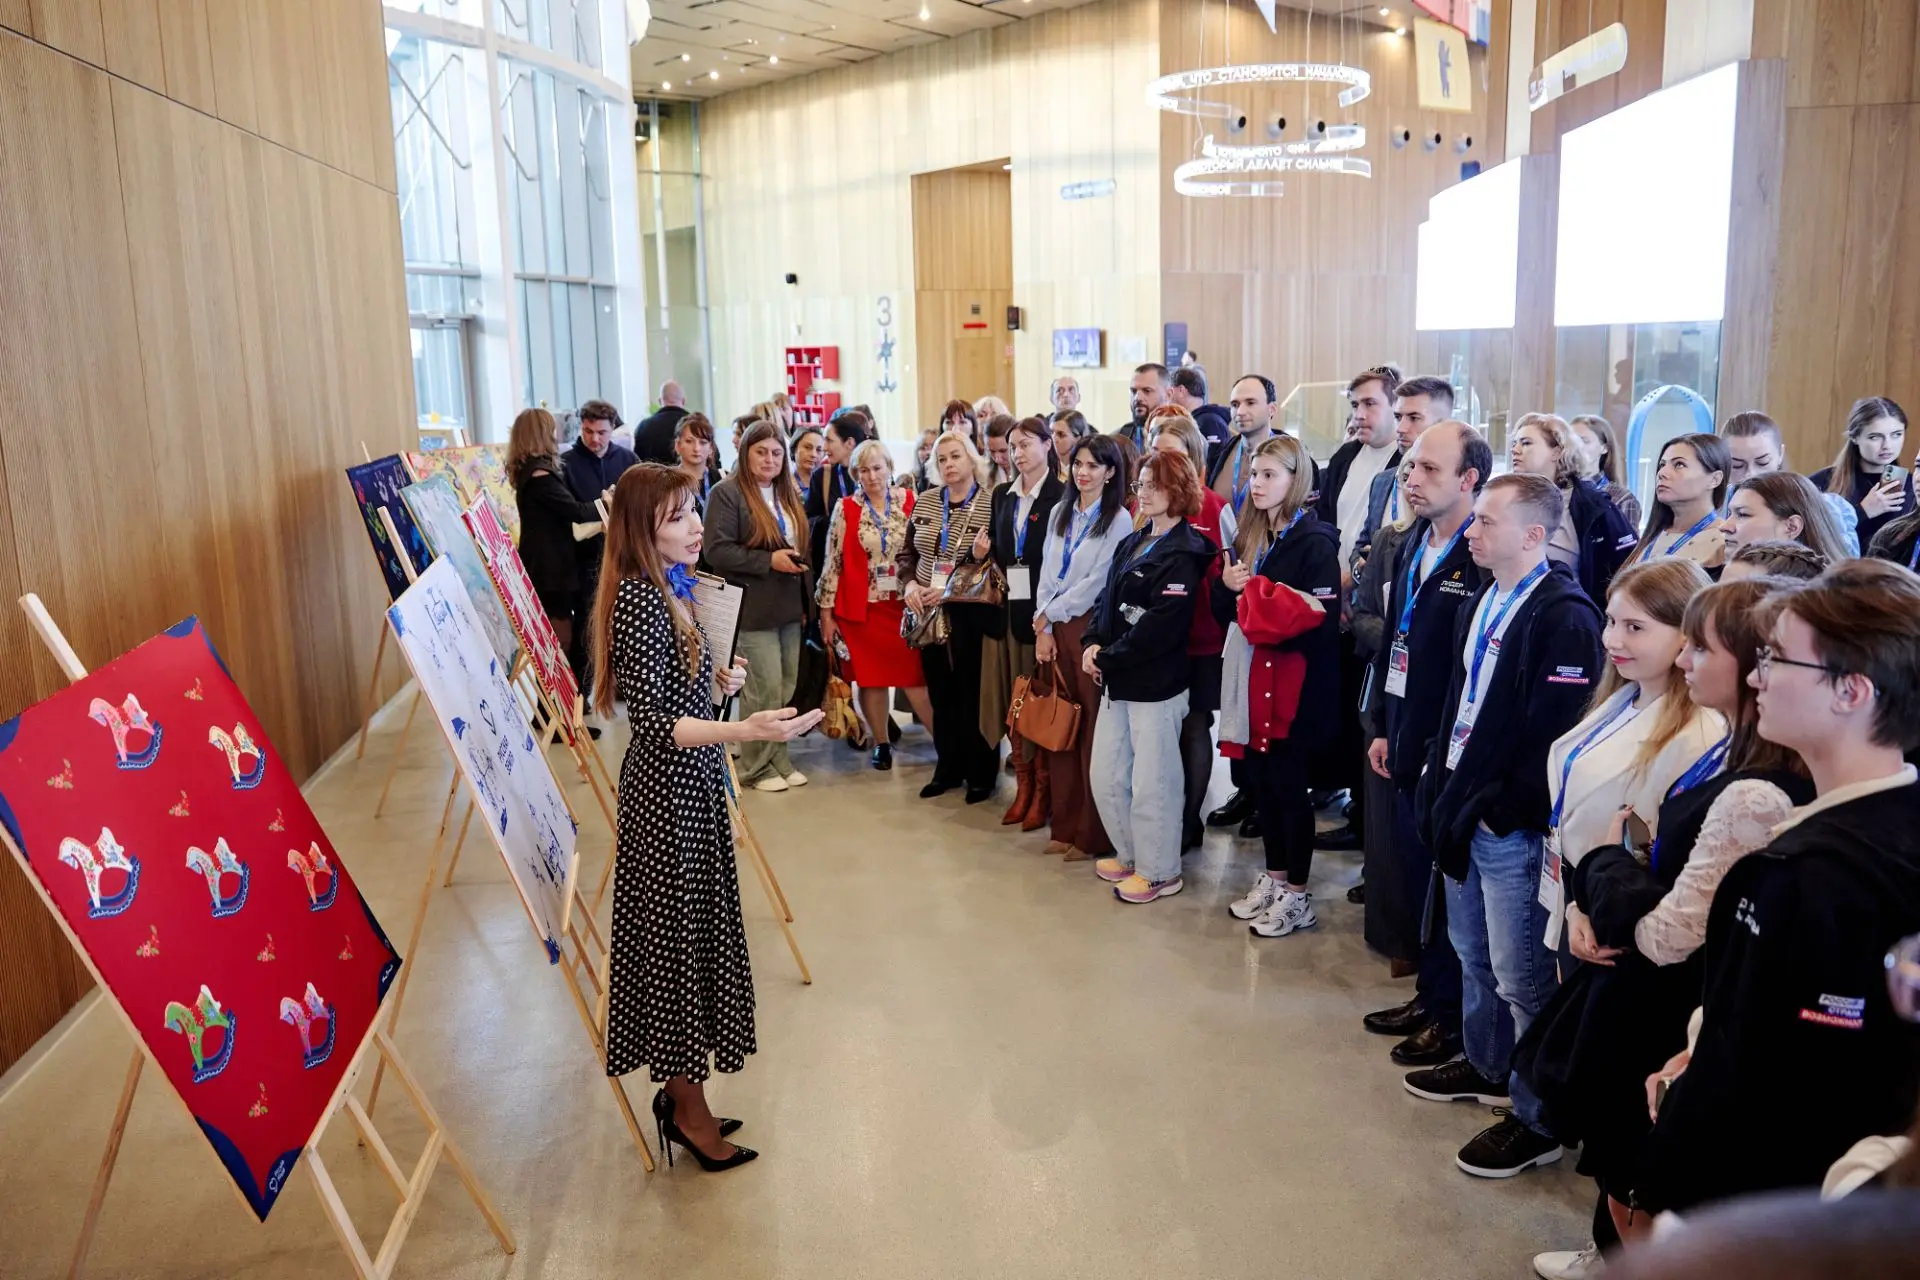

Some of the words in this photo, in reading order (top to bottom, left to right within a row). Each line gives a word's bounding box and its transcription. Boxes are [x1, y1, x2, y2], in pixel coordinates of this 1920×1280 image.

[1218, 65, 1299, 82] СТАНОВИТСЯ
[1245, 157, 1293, 172] ДЕЛАЕТ
[877, 296, 892, 327] 3
